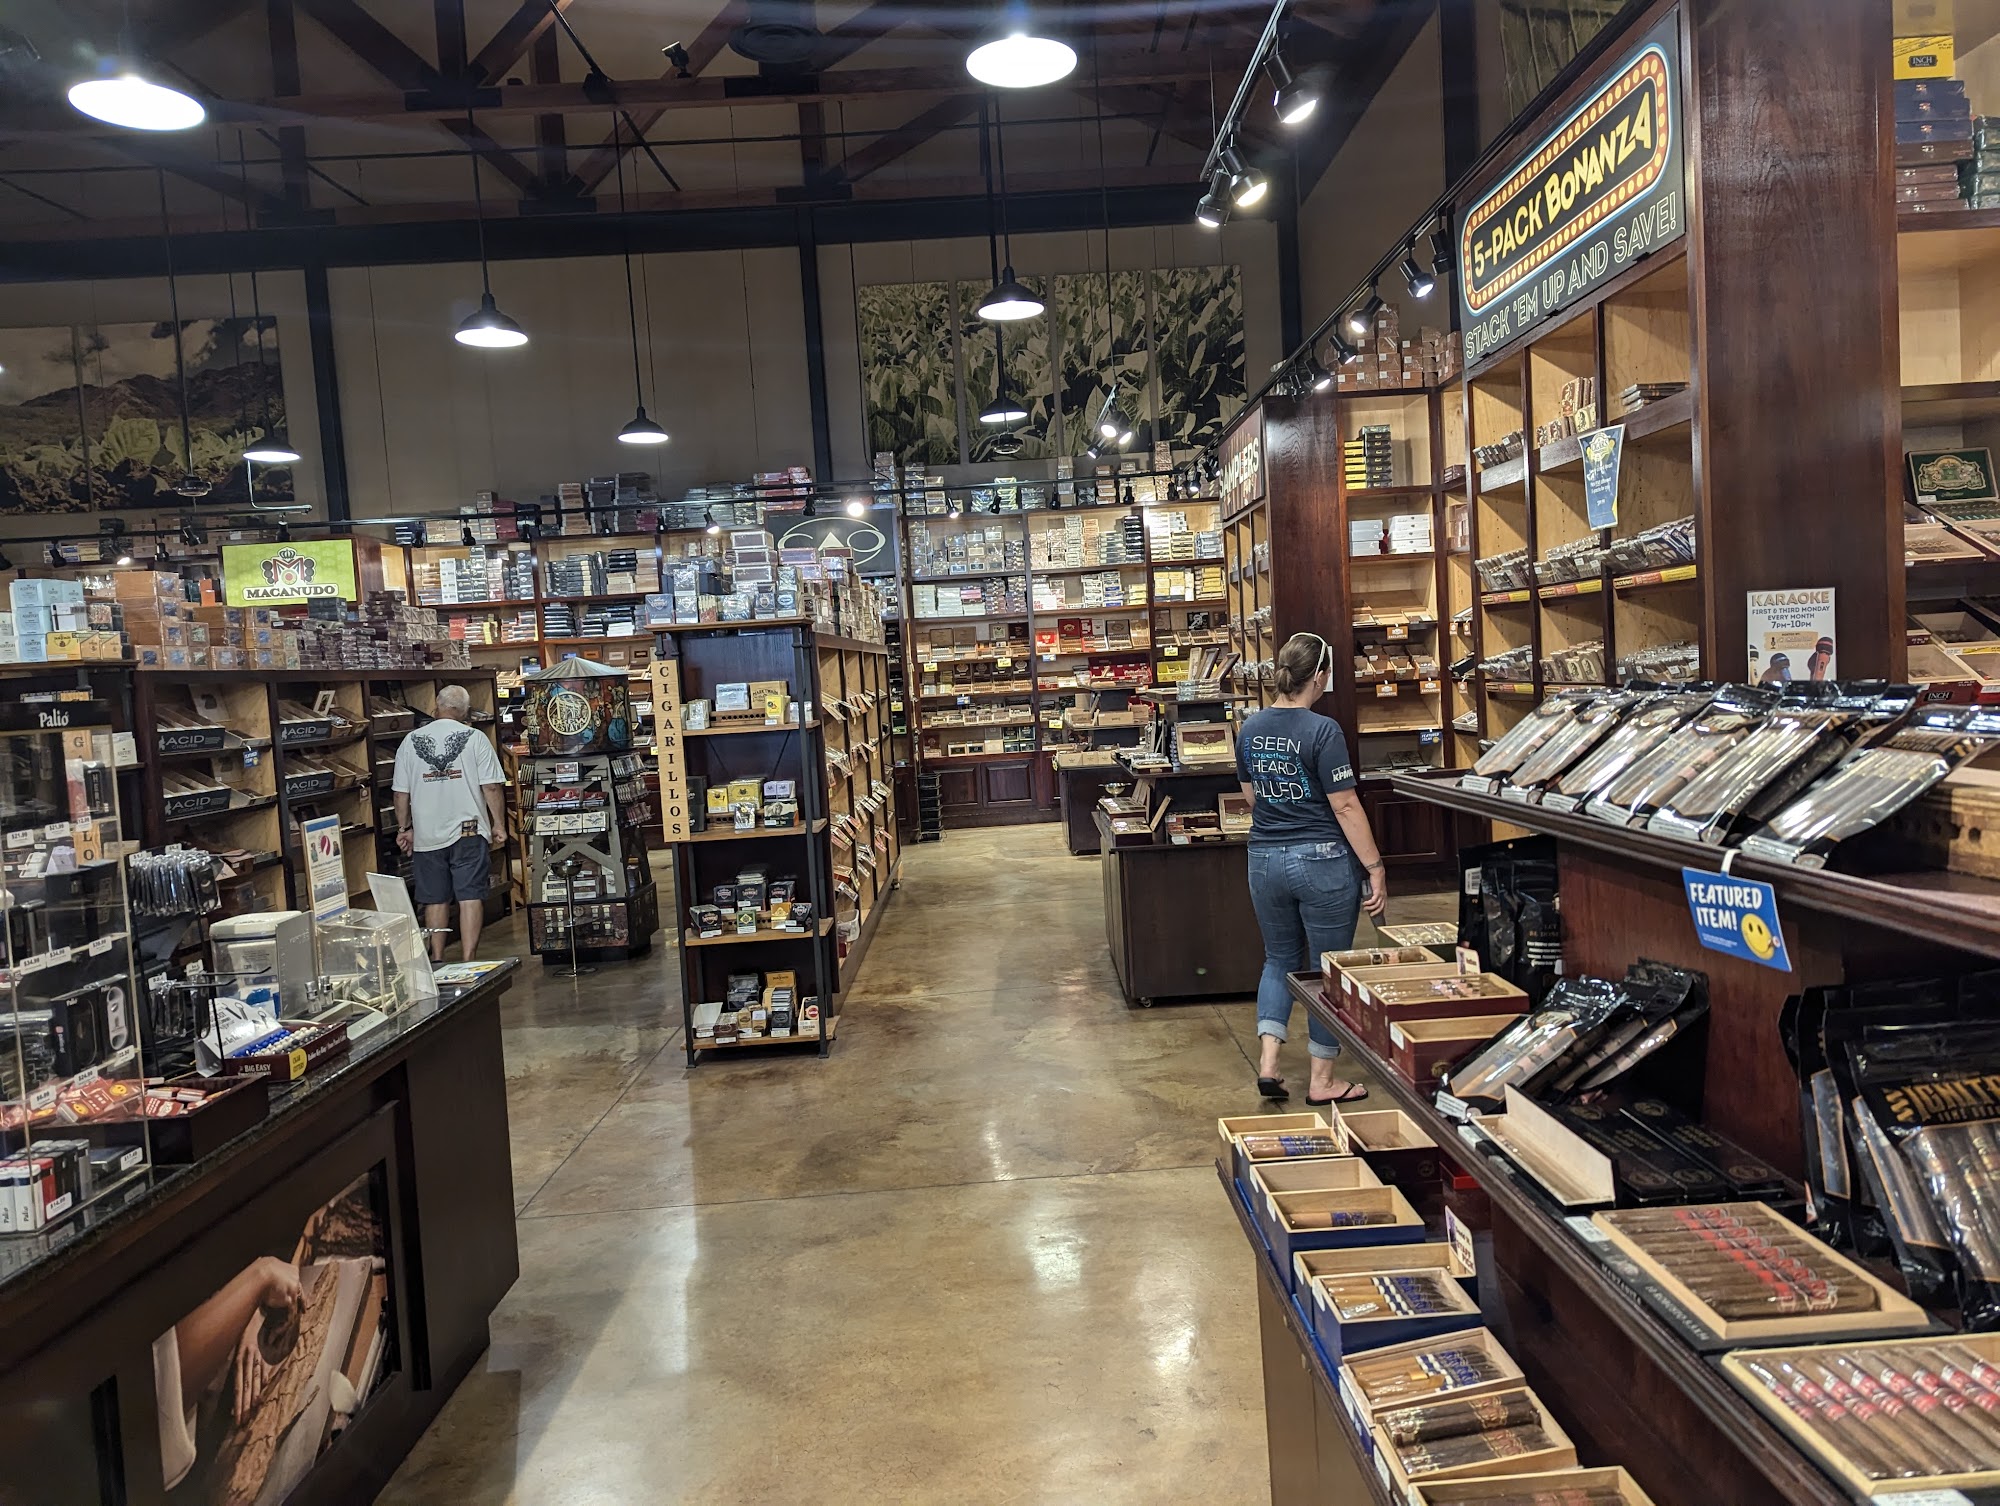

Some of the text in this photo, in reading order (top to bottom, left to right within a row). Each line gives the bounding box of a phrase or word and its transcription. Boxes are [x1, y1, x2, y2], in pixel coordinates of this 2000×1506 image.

[1912, 57, 1932, 65] INCH
[1473, 91, 1652, 278] 5-PACK BONANZA
[1466, 309, 1510, 359] STACK
[1542, 270, 1565, 309] UP
[1568, 240, 1609, 296] AND
[1613, 191, 1677, 264] SAVE!
[1219, 437, 1259, 499] SAMPLERS
[246, 585, 336, 599] MACANUDO
[1752, 591, 1830, 607] KARAOKE
[1771, 620, 1812, 628] 7PM-10PM
[1928, 691, 1950, 699] INCH
[38, 708, 70, 728] Palió
[288, 726, 317, 736] ACID
[165, 735, 205, 746] ACID
[1251, 735, 1301, 754] SEEN
[659, 665, 682, 835] CIGARILLOS
[1251, 759, 1298, 776] HEARD
[290, 779, 320, 789] ACID
[171, 796, 212, 811] ACID
[1689, 882, 1763, 910] FEATURED
[1696, 906, 1738, 932] ITEM!
[244, 1063, 271, 1072] BIG EASY
